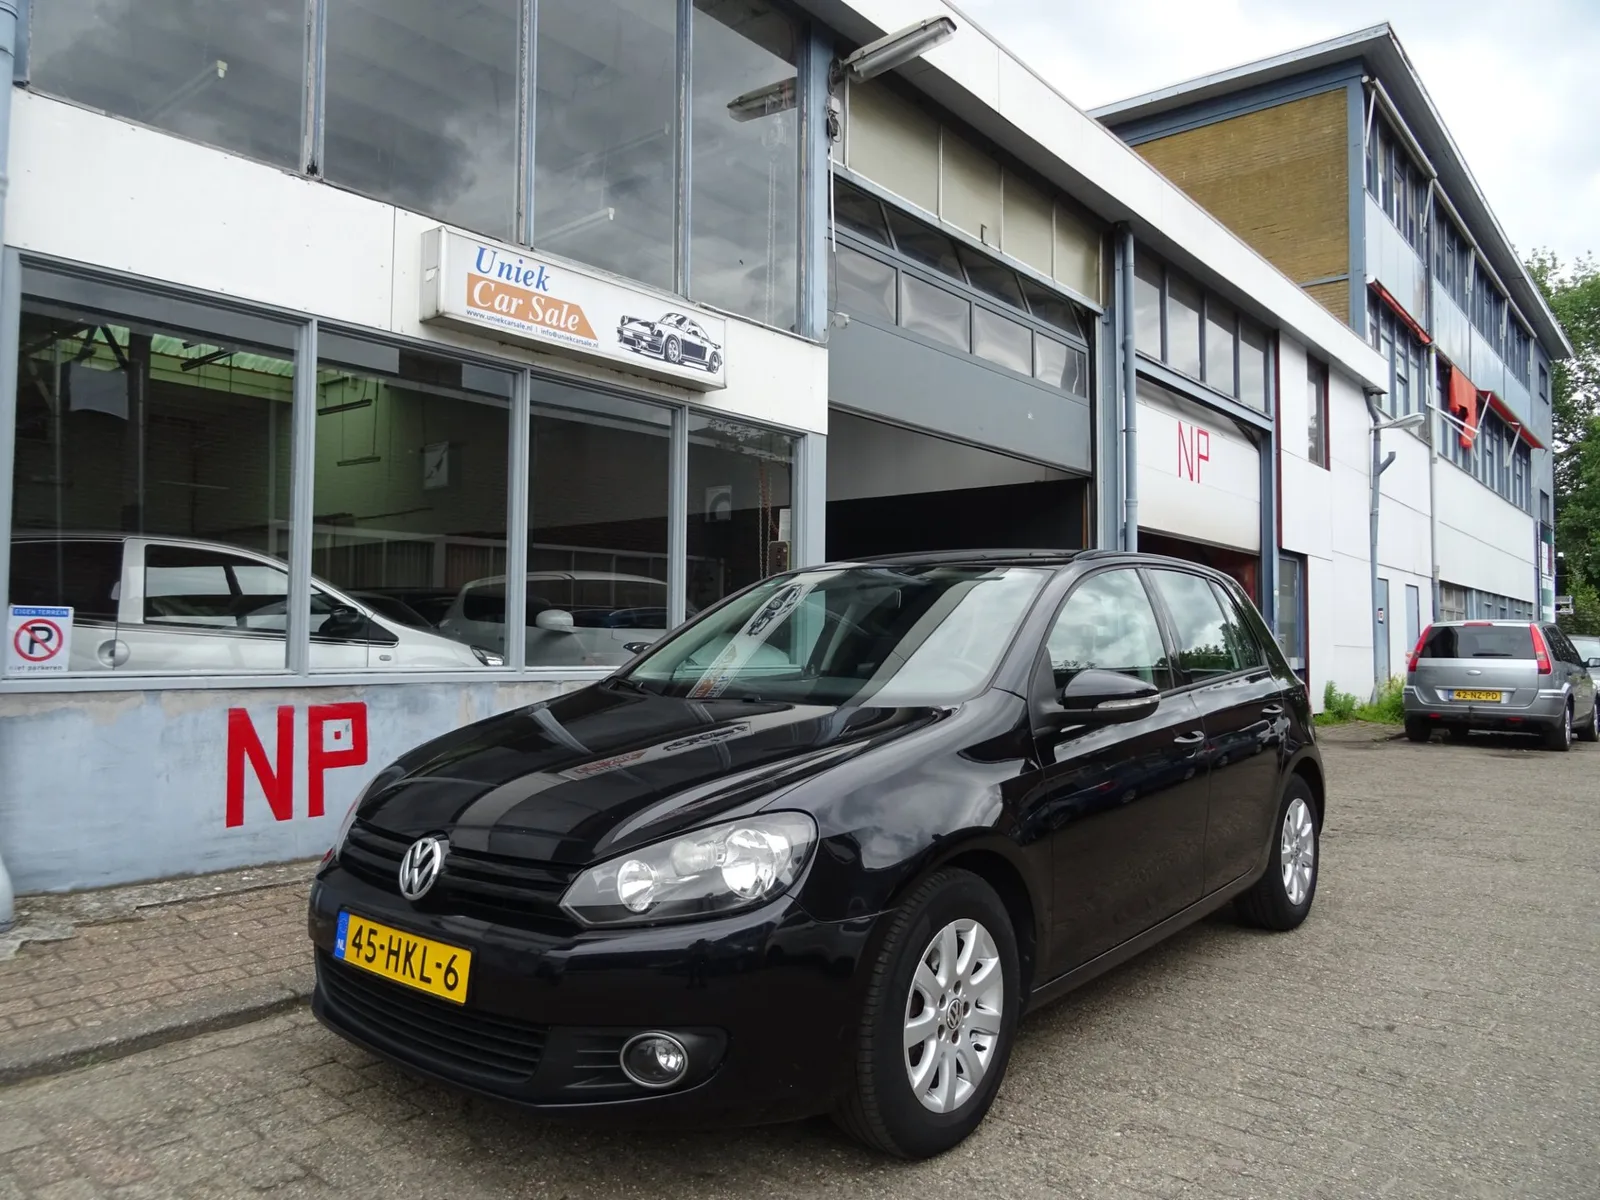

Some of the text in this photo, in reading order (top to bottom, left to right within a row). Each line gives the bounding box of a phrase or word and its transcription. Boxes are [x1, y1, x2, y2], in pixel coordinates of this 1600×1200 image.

[475, 246, 550, 291] Uniek
[473, 280, 579, 331] Car Sale
[466, 308, 599, 349] www.uniekcarsale.nl info@uniekcarsale.nl
[1178, 421, 1209, 484] NP
[14, 608, 36, 616] EIGEN
[28, 626, 54, 655] P
[1456, 691, 1498, 700] 42-NZ-PD
[226, 702, 368, 828] NP
[337, 938, 346, 951] NL
[351, 925, 459, 991] 45-HKL-6
